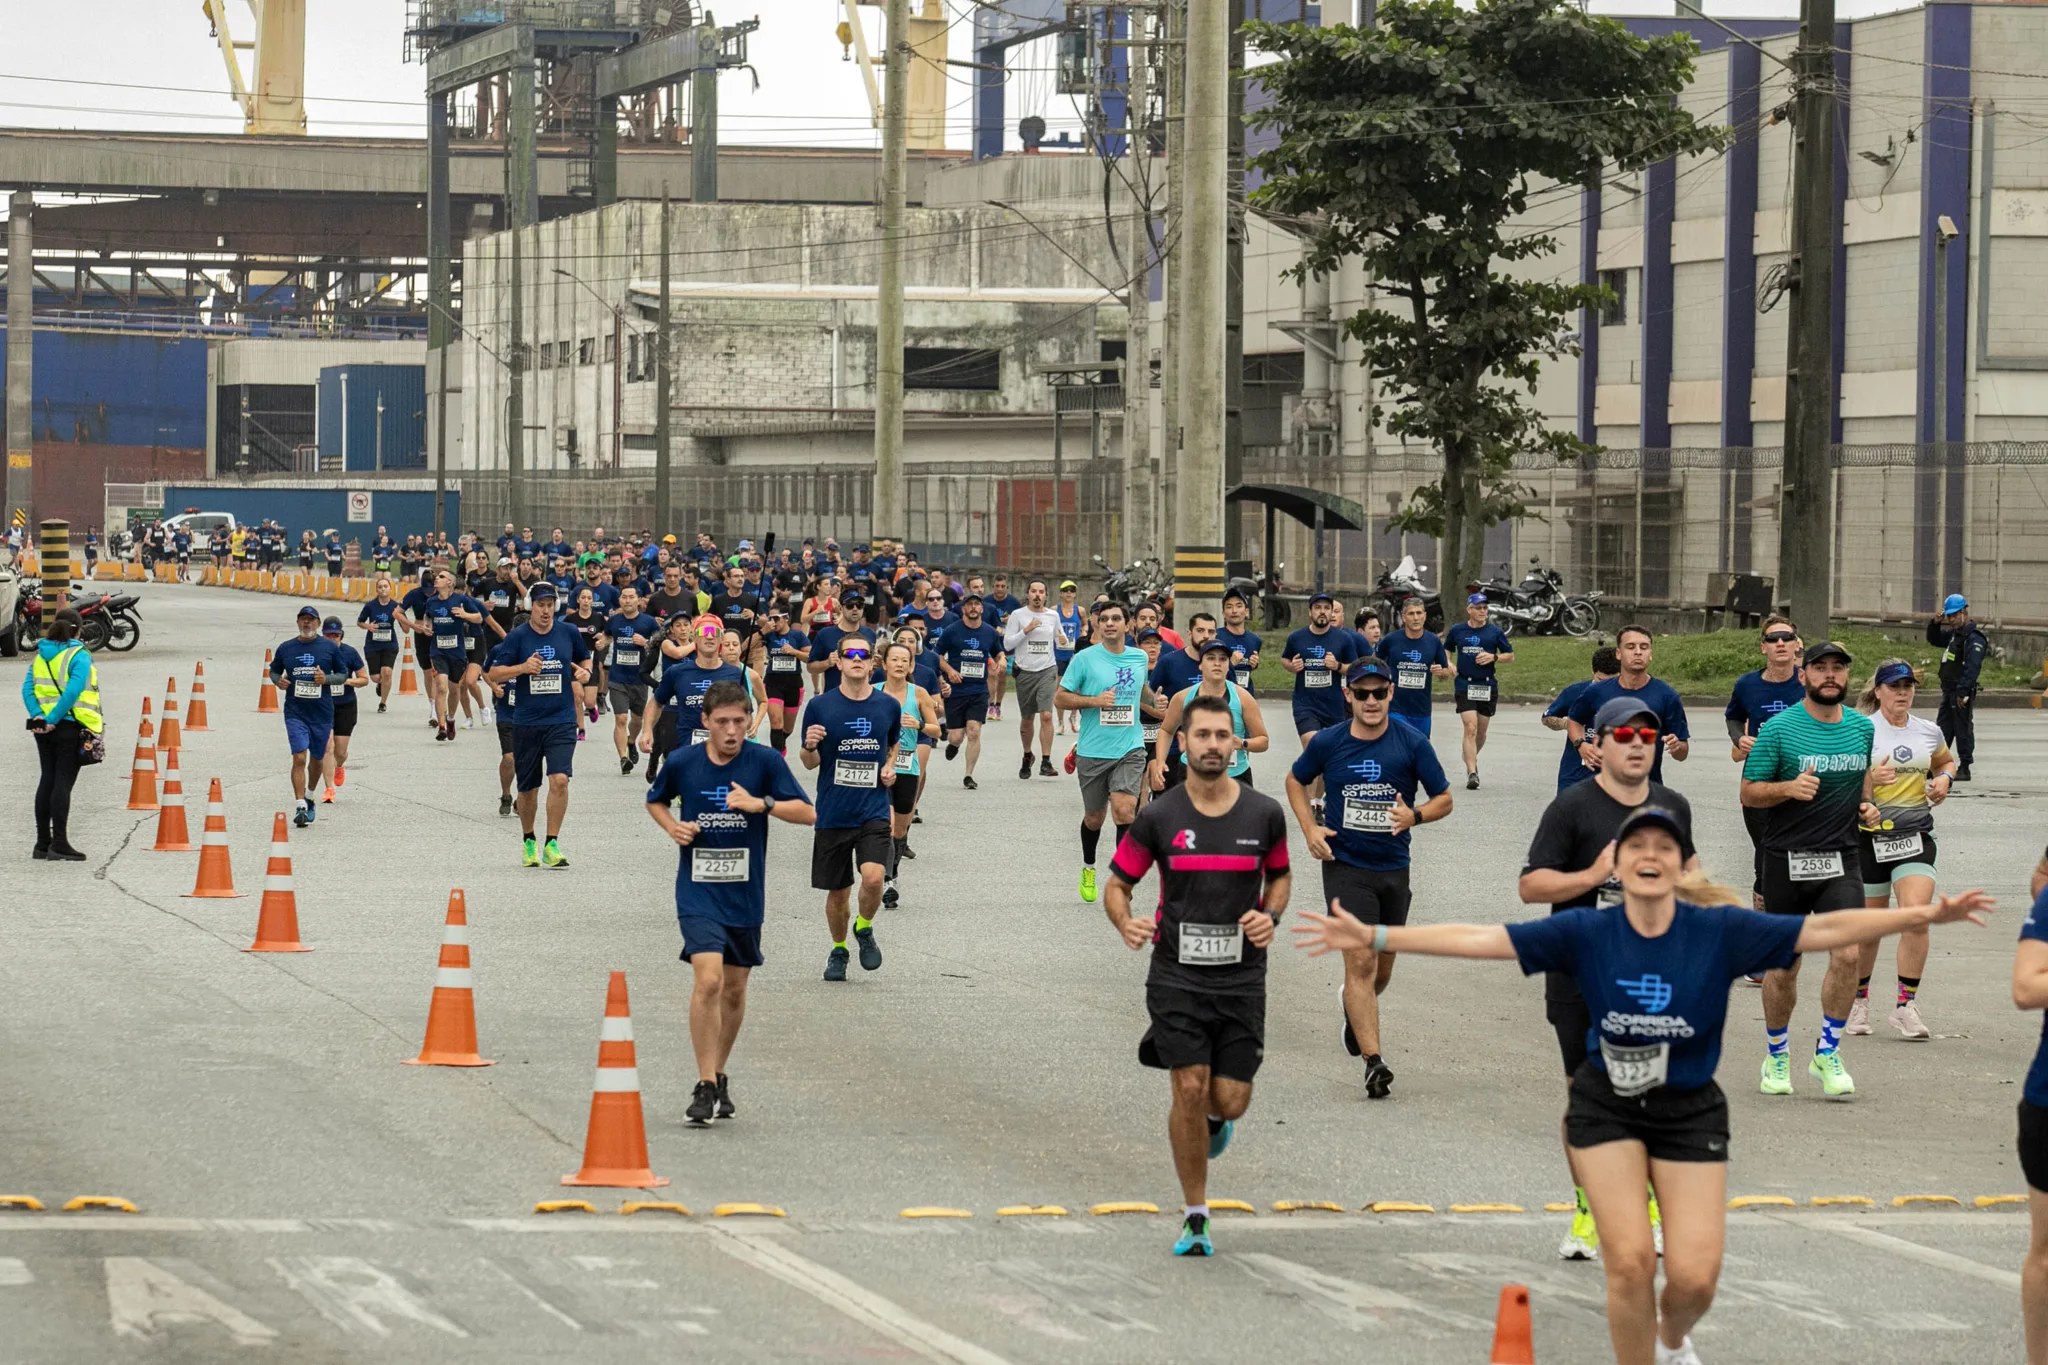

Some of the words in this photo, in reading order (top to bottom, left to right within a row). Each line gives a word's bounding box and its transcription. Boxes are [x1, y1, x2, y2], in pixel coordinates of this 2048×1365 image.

[1107, 711, 1128, 720] 2505
[895, 755, 906, 763] 08
[844, 769, 869, 780] 2172
[1344, 783, 1393, 791] CORRIDA
[1360, 788, 1397, 797] PORTO
[697, 812, 745, 821] CORRIDA
[1355, 810, 1386, 823] 2445
[696, 820, 711, 828] DO
[1171, 829, 1196, 849] 4R
[1884, 838, 1913, 853] 2060
[704, 861, 737, 872] 2257
[1801, 859, 1832, 871] 2536
[1194, 938, 1230, 952] 2117
[1606, 1010, 1688, 1028] CORRIDA
[1600, 1018, 1626, 1035] DO
[1629, 1025, 1695, 1038] PORTO
